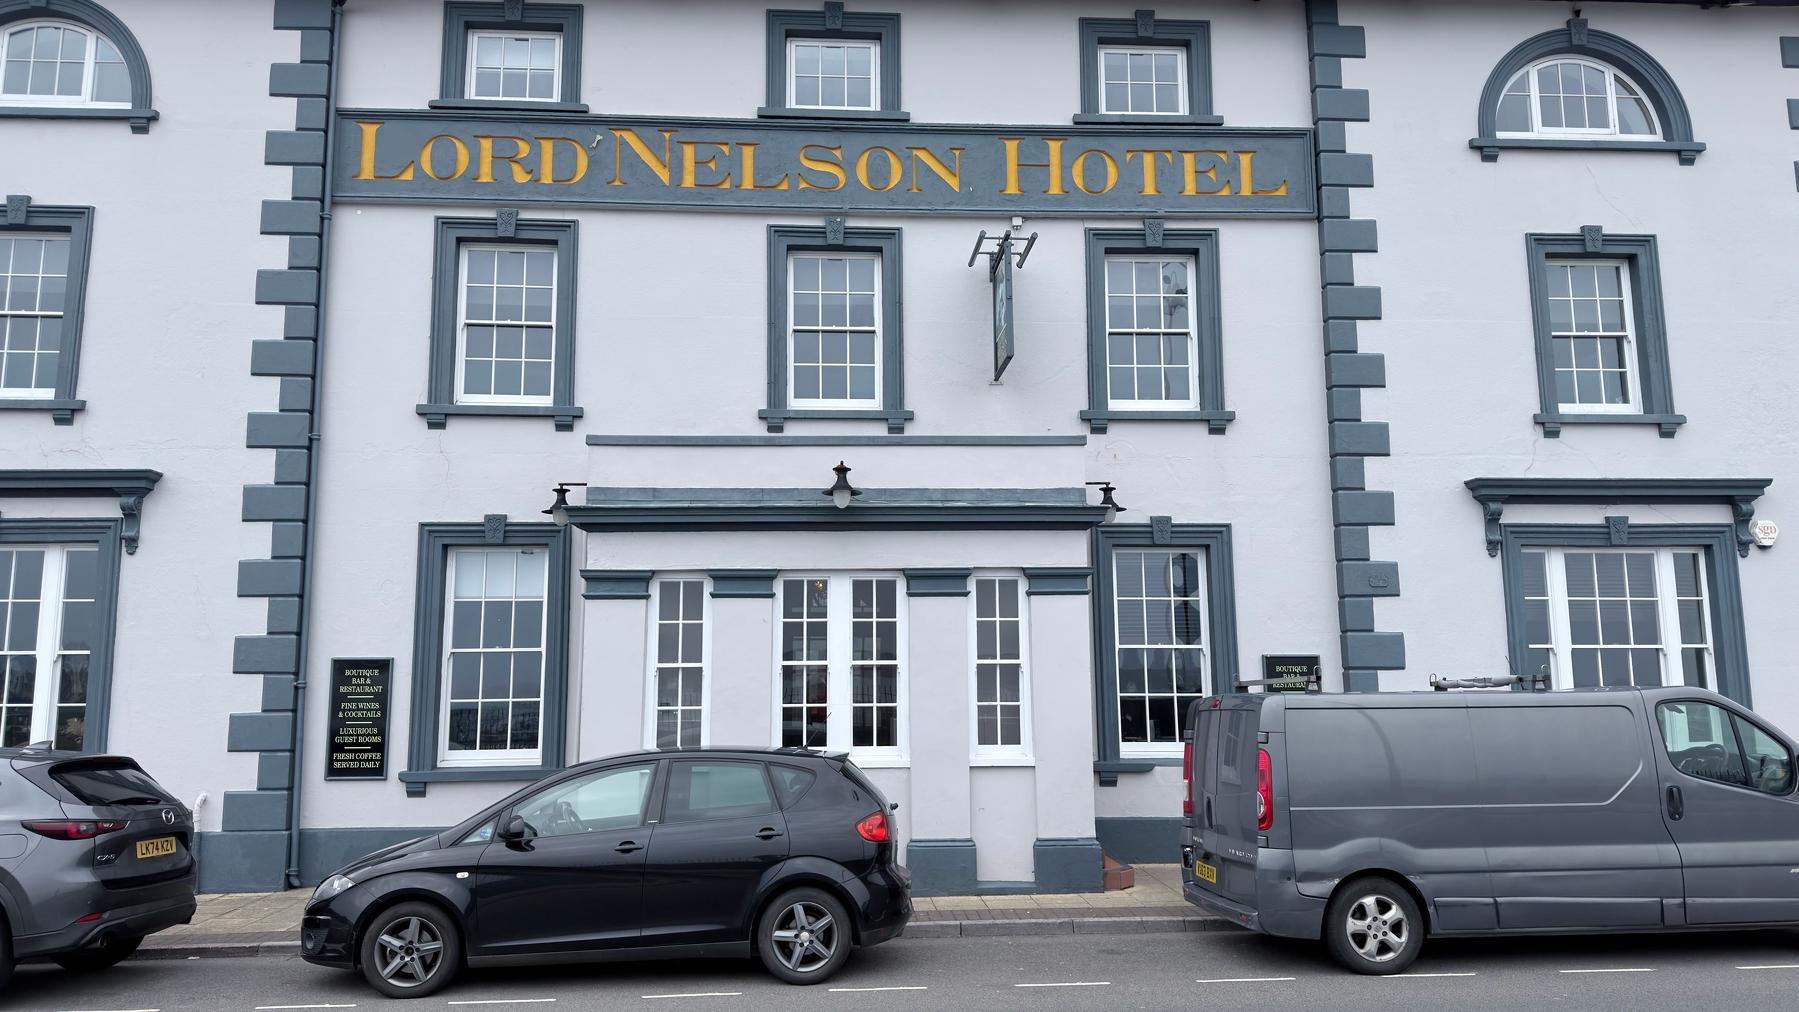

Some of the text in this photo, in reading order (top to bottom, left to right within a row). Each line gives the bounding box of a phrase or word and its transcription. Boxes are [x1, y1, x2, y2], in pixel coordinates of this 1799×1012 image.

[351, 121, 1288, 197] LORD NELSON HOTEL
[345, 669, 379, 677] BOUTIQUE
[1275, 665, 1307, 673] BOUTIQUE
[339, 685, 383, 693] RESTAURANT
[341, 702, 380, 710] FINE WINES
[344, 710, 381, 718] COCKTAILS
[339, 727, 378, 735] LUXURIOUS
[355, 752, 382, 760] COFFEE
[333, 761, 381, 769] SERVED DAILY
[140, 841, 160, 856] LK74
